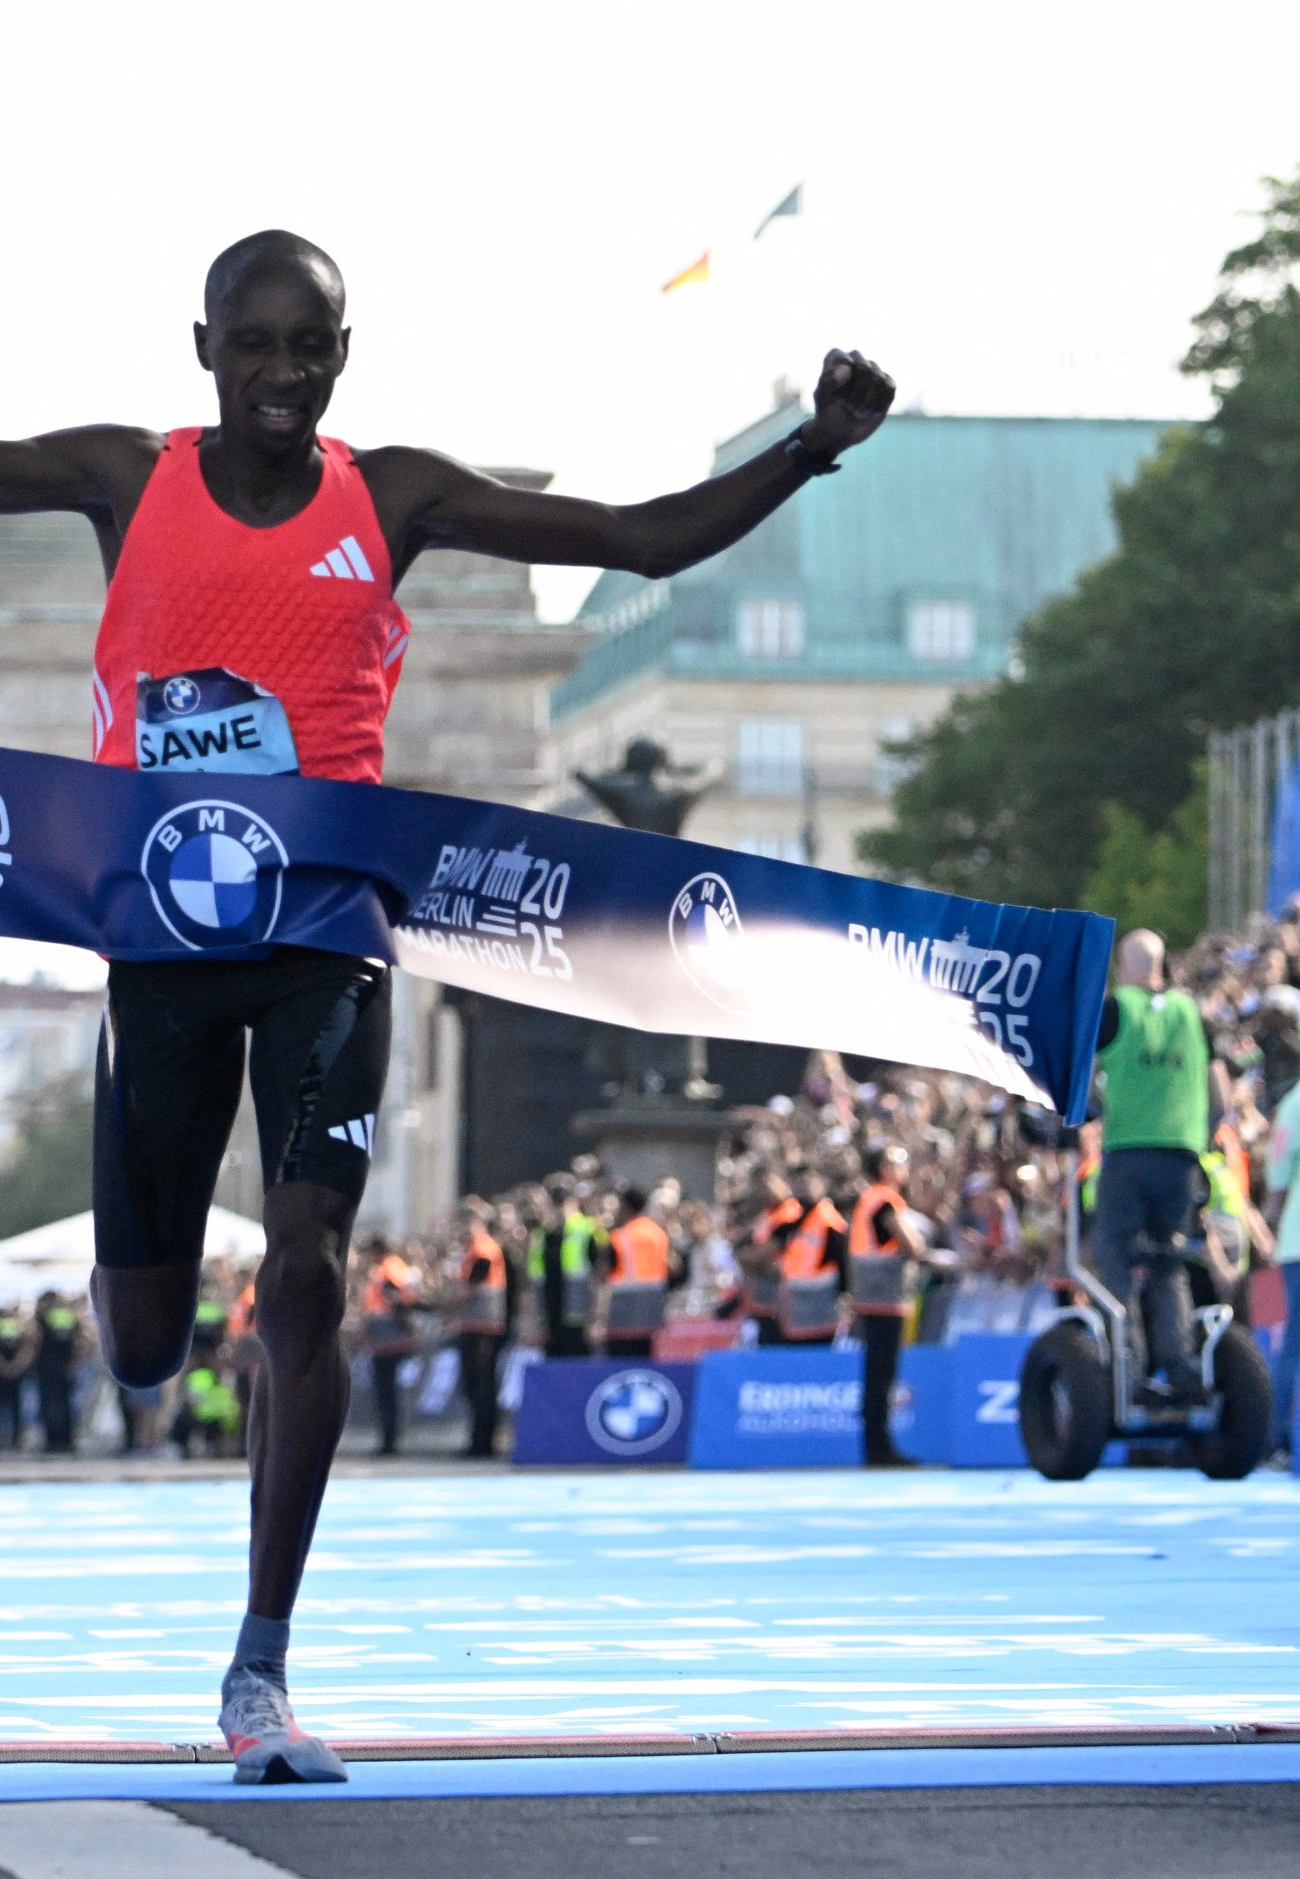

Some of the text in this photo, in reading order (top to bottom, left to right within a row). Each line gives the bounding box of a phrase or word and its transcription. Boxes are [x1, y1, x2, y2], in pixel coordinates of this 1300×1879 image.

[140, 714, 262, 769] SAWE
[158, 809, 271, 853] BMW
[408, 892, 475, 929] ERLIN
[520, 858, 571, 920] 20
[679, 881, 733, 926] BMW
[520, 921, 573, 981] 25
[976, 950, 1042, 1008] 20
